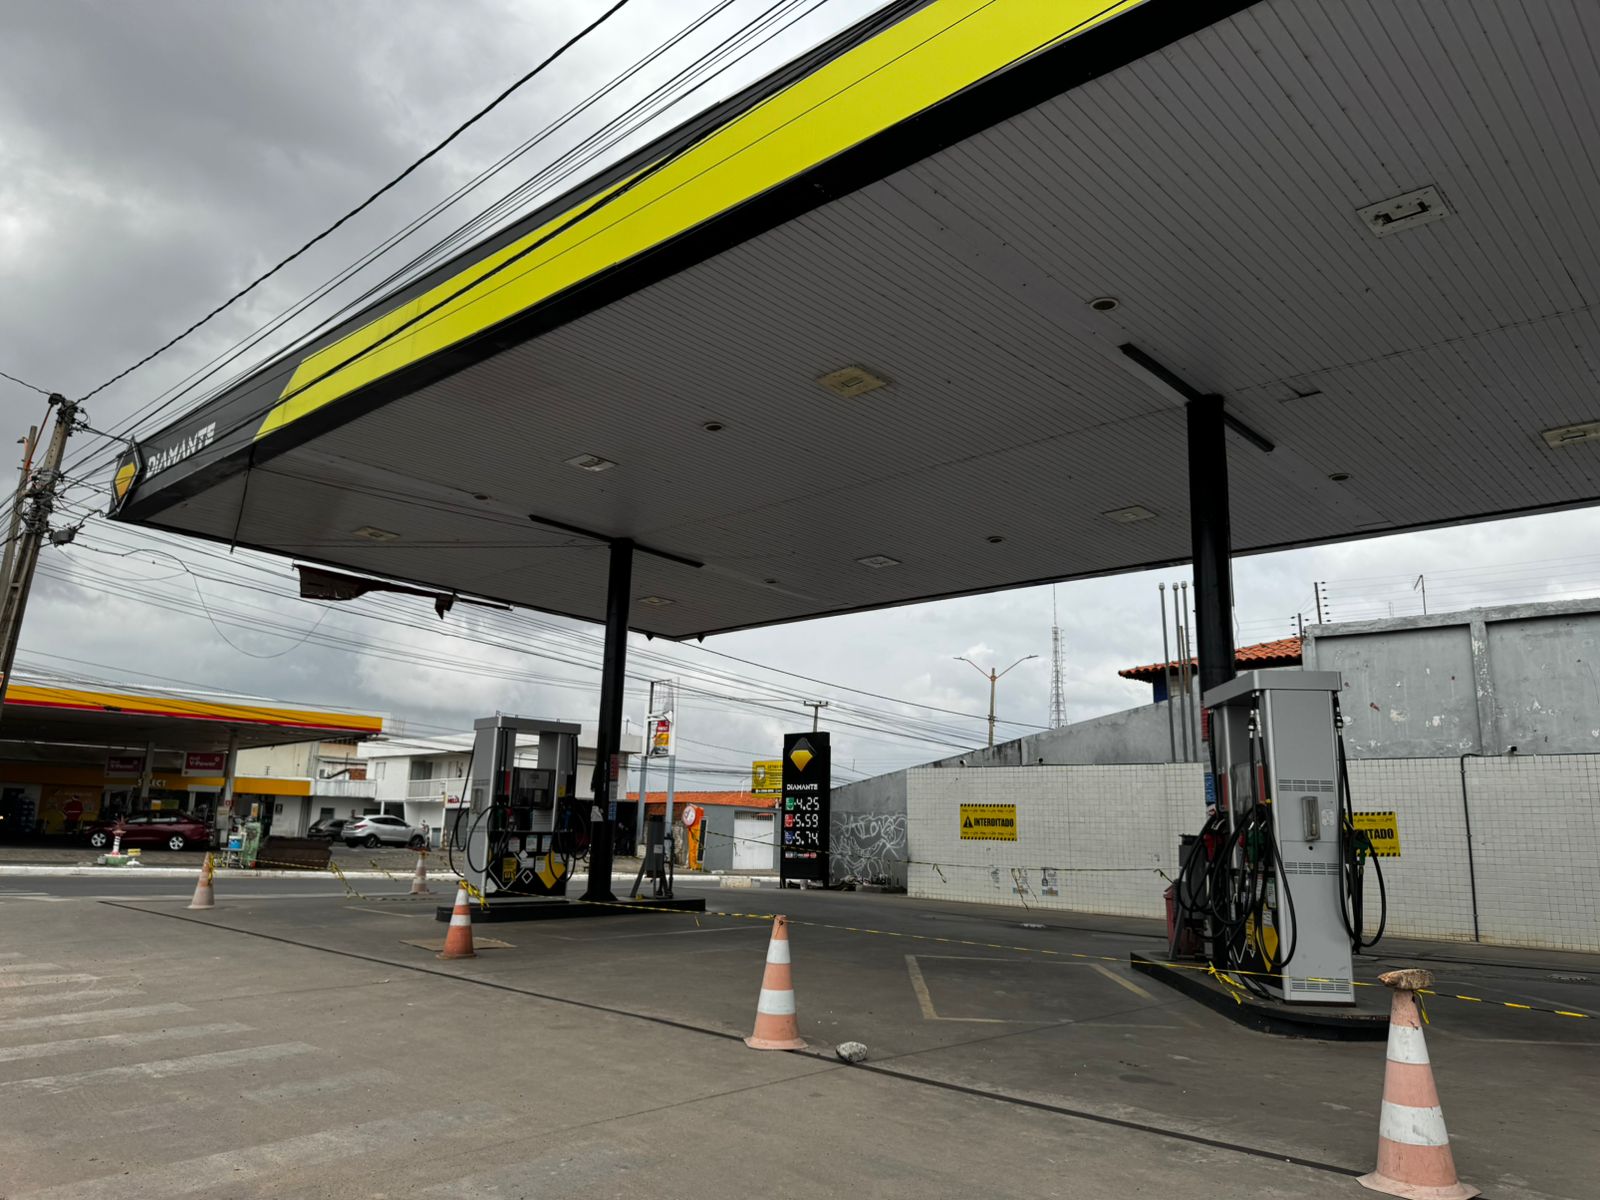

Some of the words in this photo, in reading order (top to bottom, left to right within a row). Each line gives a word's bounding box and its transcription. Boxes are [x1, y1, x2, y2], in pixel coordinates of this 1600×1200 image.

[145, 422, 216, 479] DIAMANTE
[786, 783, 818, 791] DIAMANTE
[796, 797, 820, 810] 4.25
[973, 817, 1014, 828] INTERDITADO
